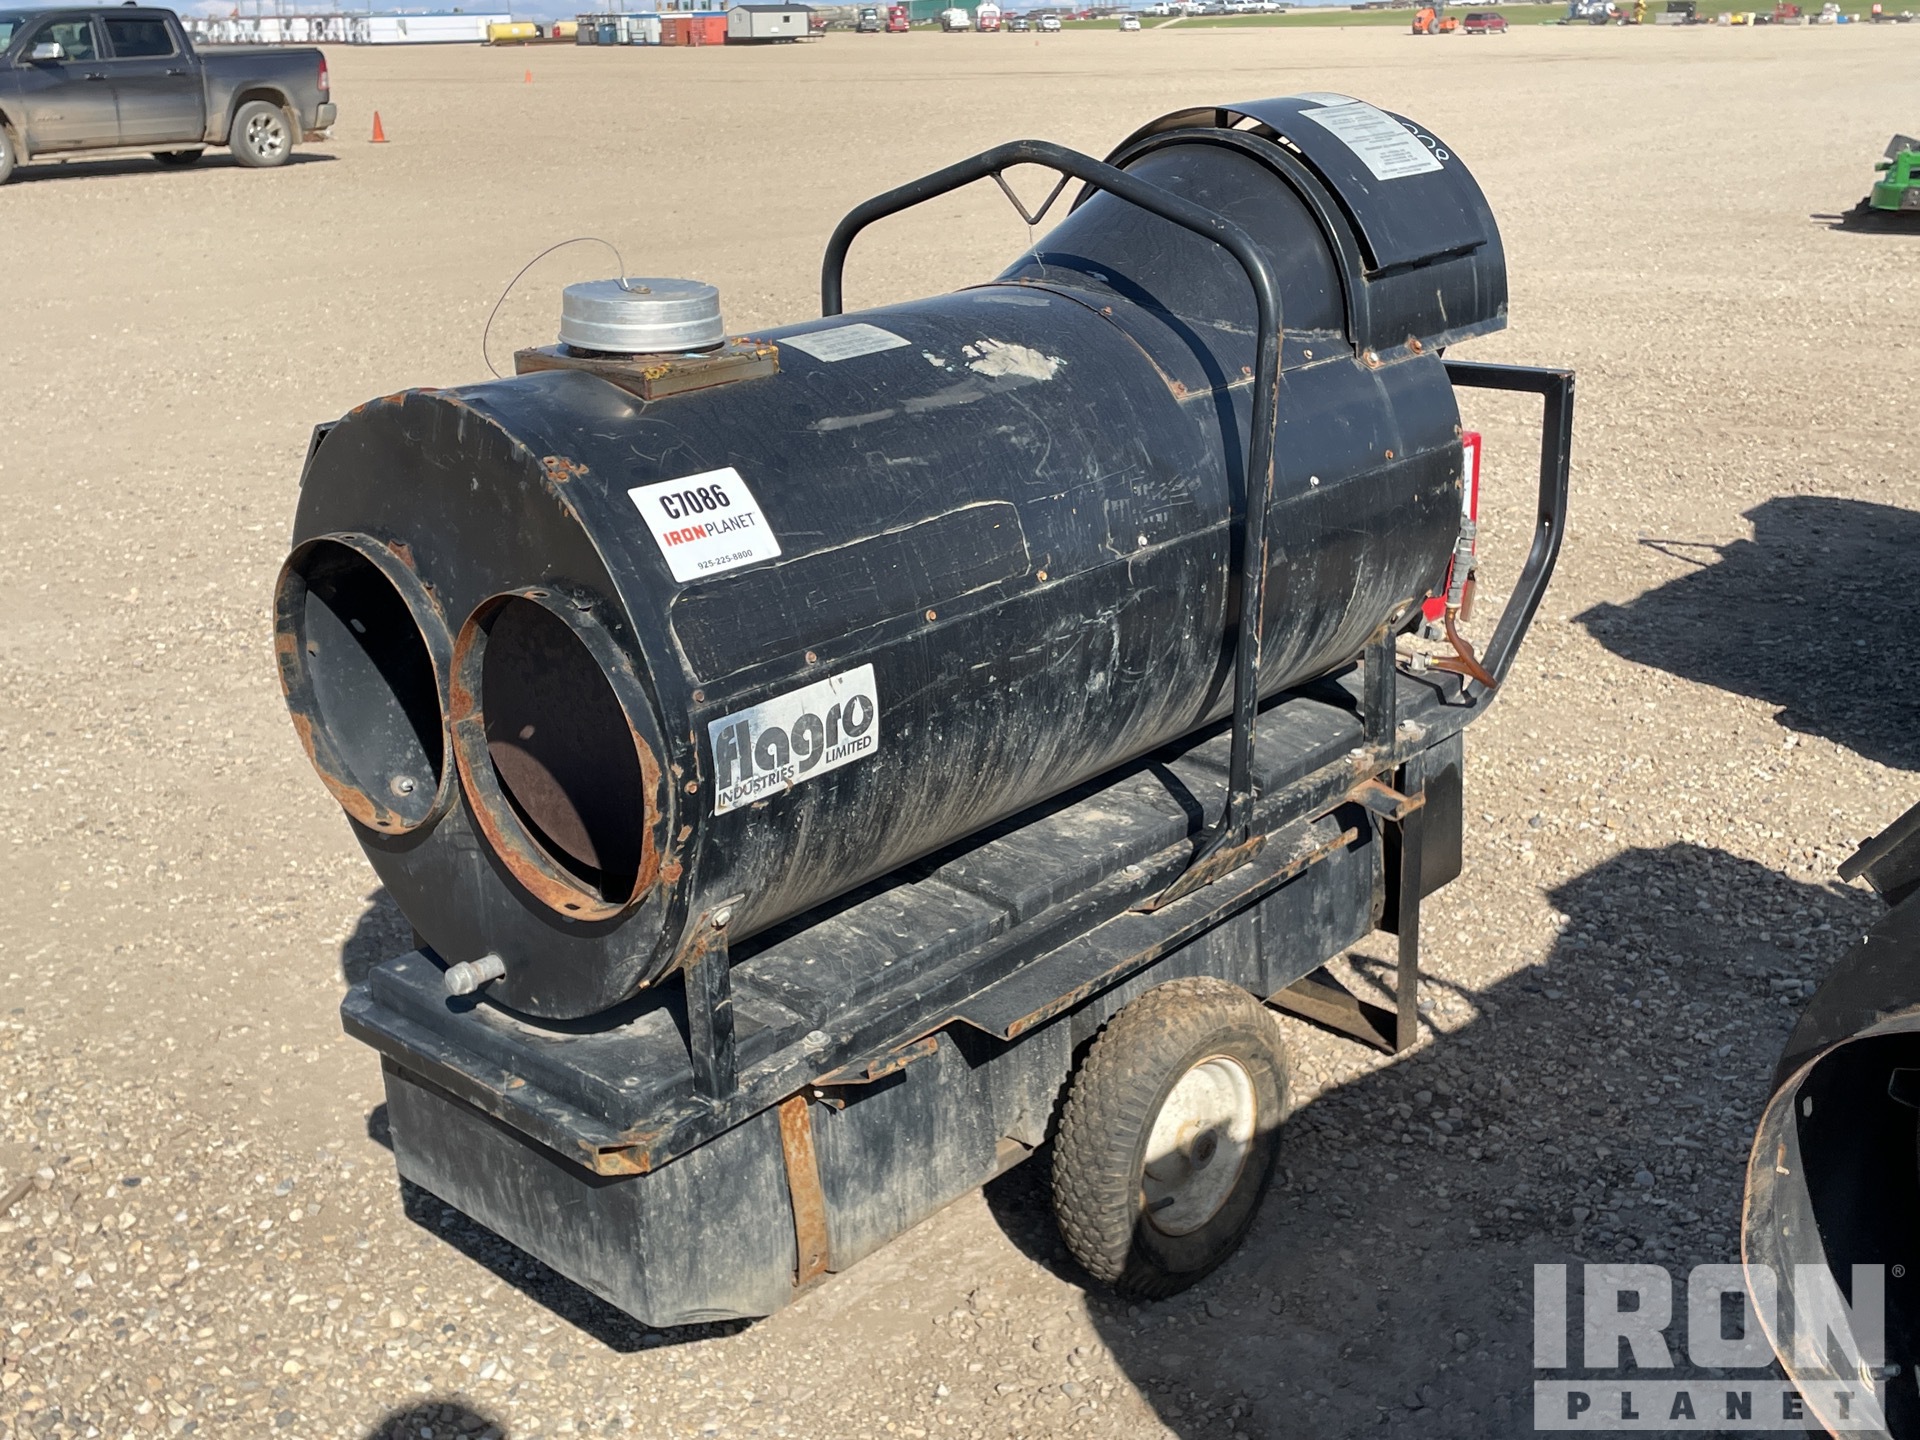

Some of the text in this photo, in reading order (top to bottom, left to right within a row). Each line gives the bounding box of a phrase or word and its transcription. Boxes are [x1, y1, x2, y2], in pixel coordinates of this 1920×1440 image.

[659, 484, 731, 519] C7086
[697, 549, 753, 570] 925-225-8800
[716, 694, 874, 791] flagro
[718, 735, 872, 804] INDUSTRIES LIMITED
